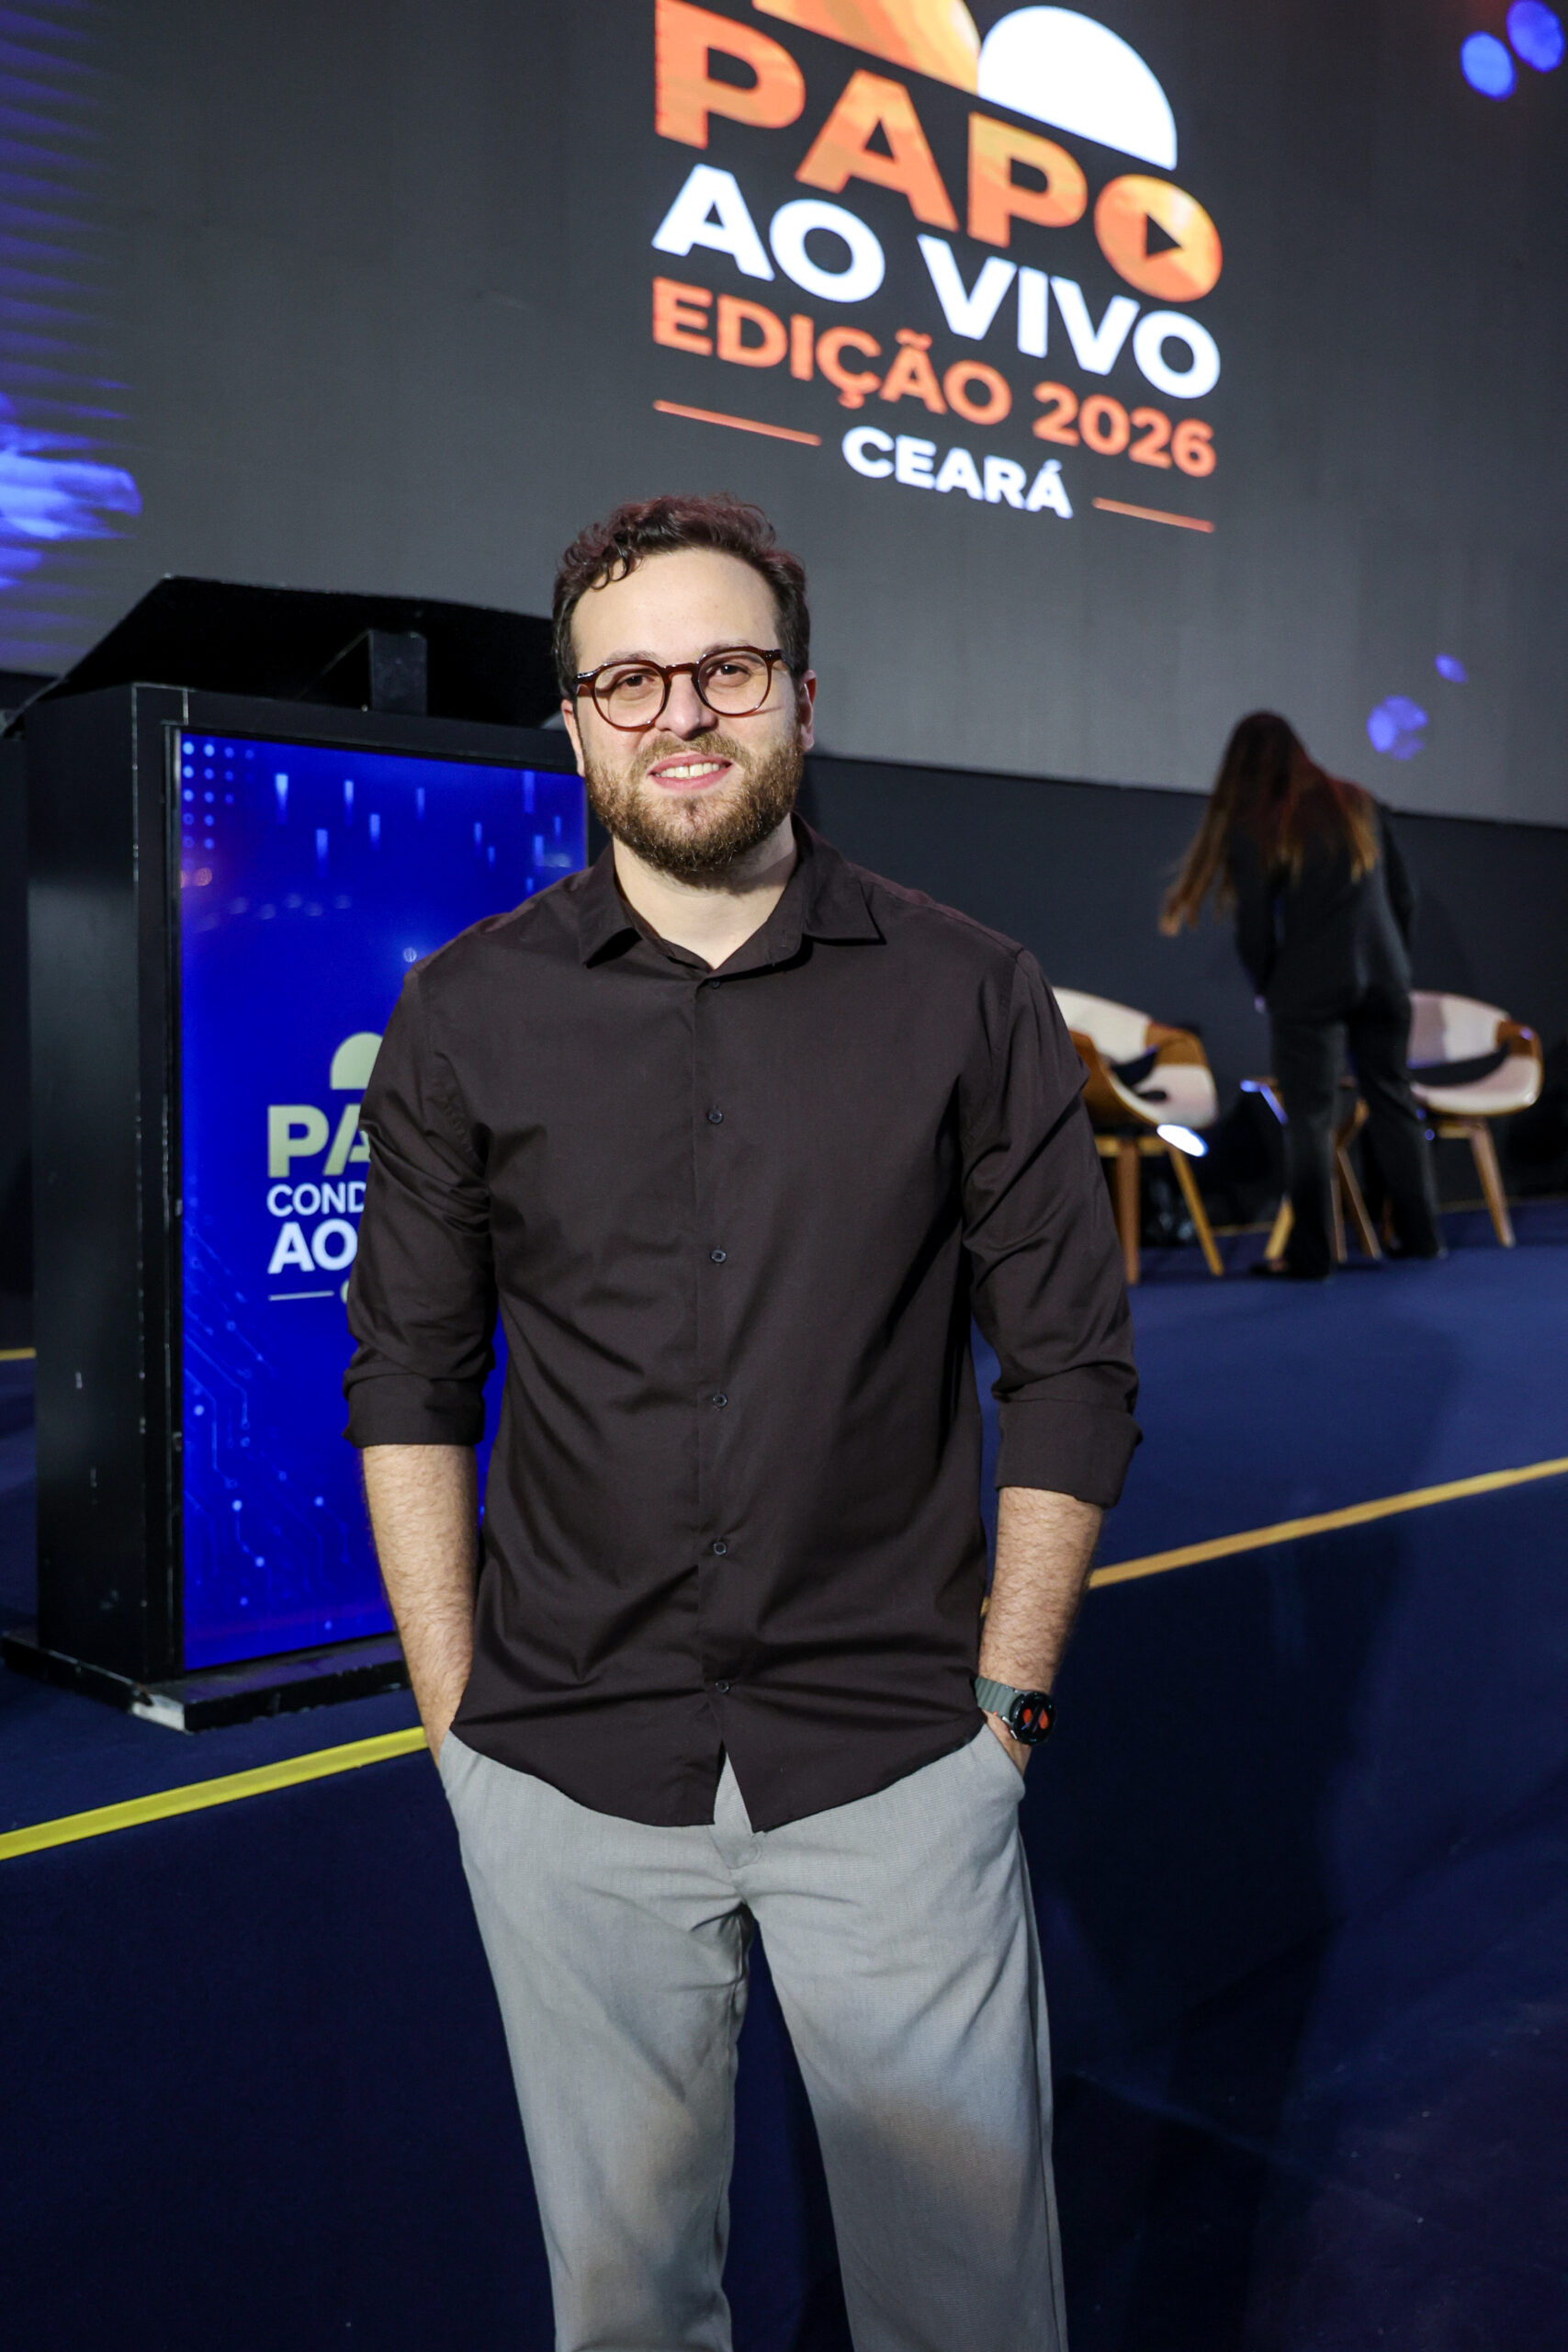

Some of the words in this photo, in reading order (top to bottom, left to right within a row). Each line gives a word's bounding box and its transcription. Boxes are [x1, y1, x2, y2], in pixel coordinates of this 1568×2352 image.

[654, 0, 1224, 302] PAPO
[651, 163, 886, 302] AO
[917, 233, 1221, 399] VIVO
[652, 277, 1011, 425] EDIÇÃO
[1032, 380, 1217, 478] 2026
[841, 425, 1073, 519] CEARÁ
[267, 1218, 359, 1274] AO
